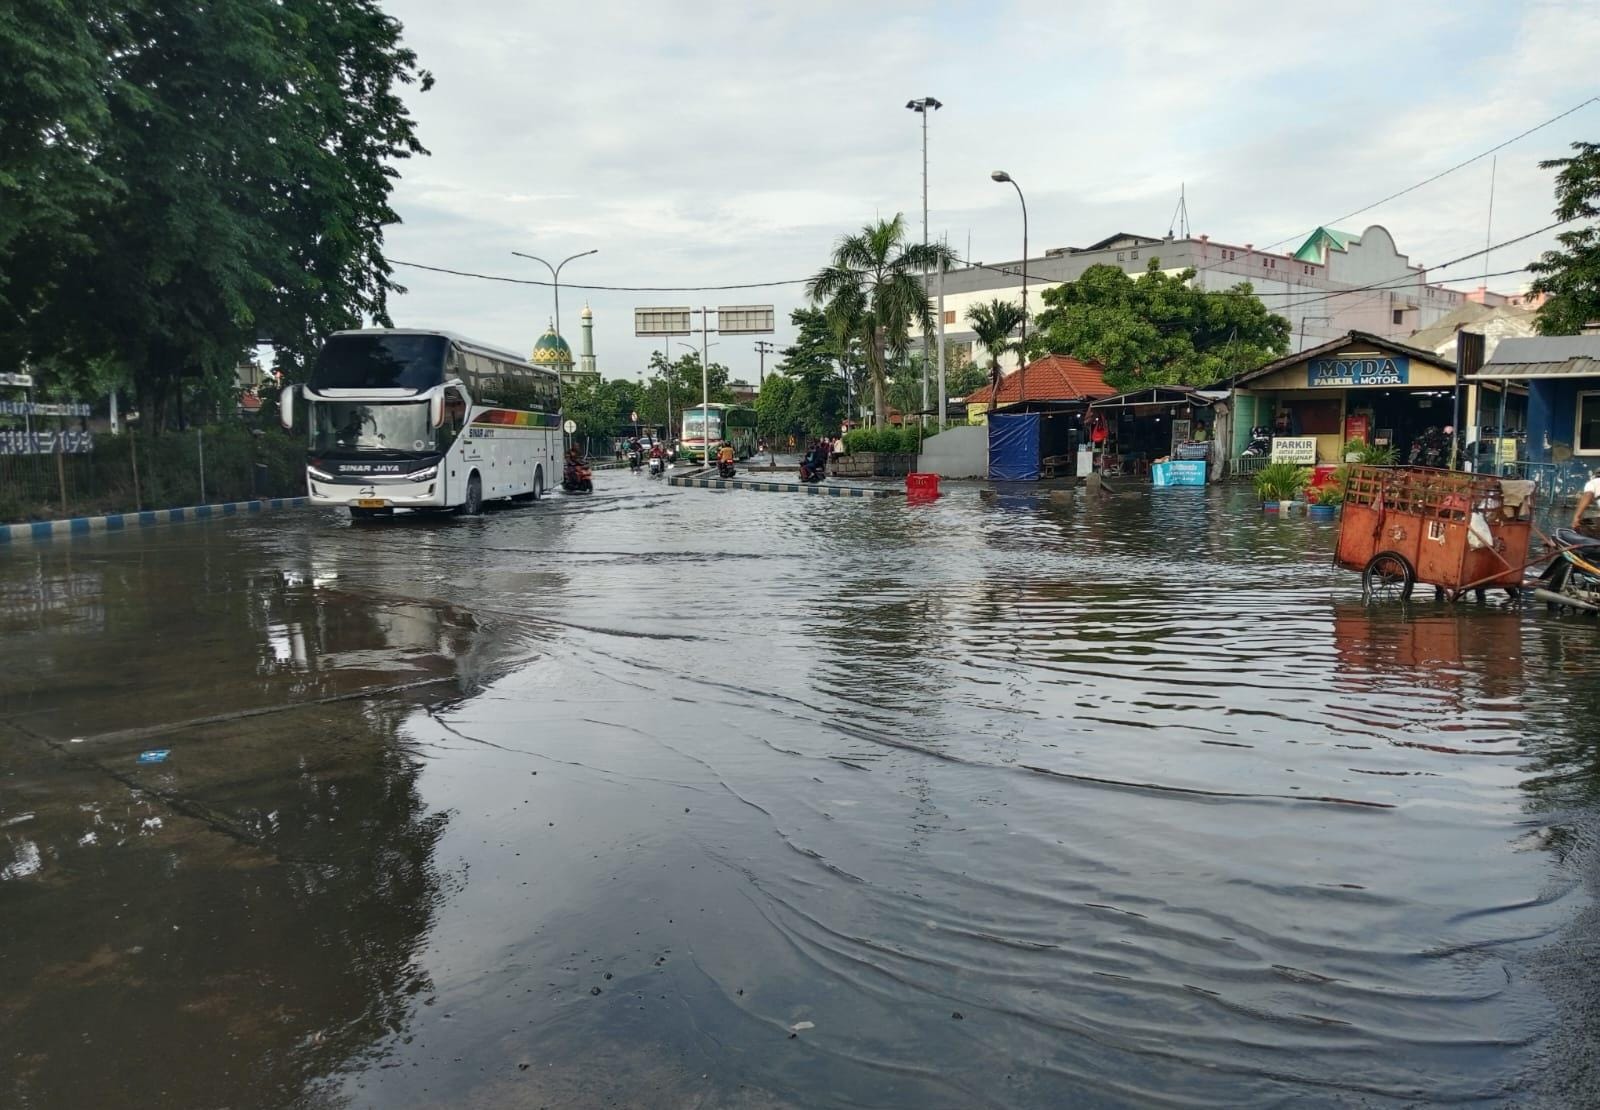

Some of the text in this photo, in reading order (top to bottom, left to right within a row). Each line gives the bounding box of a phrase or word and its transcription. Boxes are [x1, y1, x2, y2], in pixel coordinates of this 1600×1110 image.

[1318, 358, 1399, 377] MYDA
[1313, 377, 1353, 385] PARKIR
[1360, 376, 1401, 385] MOTOR
[469, 428, 483, 437] SINAR
[1276, 440, 1312, 449] PARKIR
[338, 464, 399, 472] SINAR JAYA
